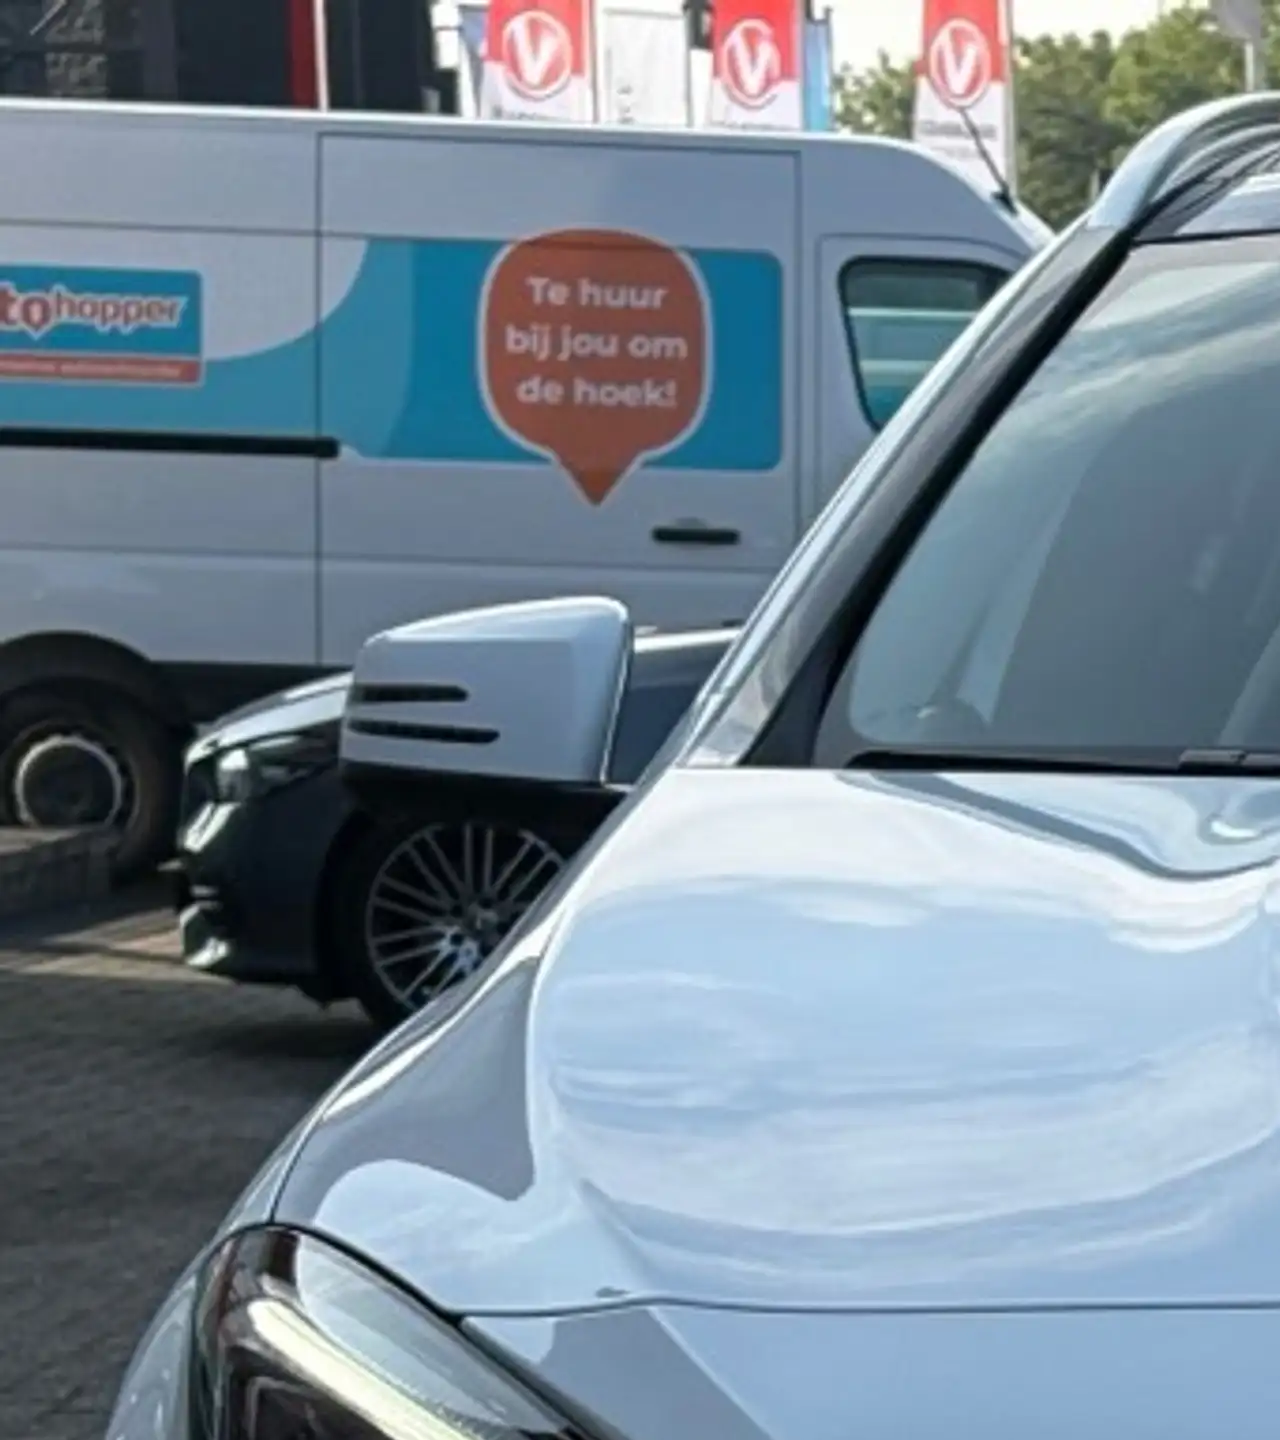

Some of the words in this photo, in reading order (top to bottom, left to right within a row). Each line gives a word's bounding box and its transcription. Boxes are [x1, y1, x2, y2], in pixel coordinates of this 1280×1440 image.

[526, 276, 570, 306] Te
[577, 277, 668, 309] huur
[505, 323, 550, 362] bij
[557, 324, 619, 362] jou
[627, 333, 689, 361] om
[516, 374, 565, 405] de
[573, 376, 677, 408] hoek!
